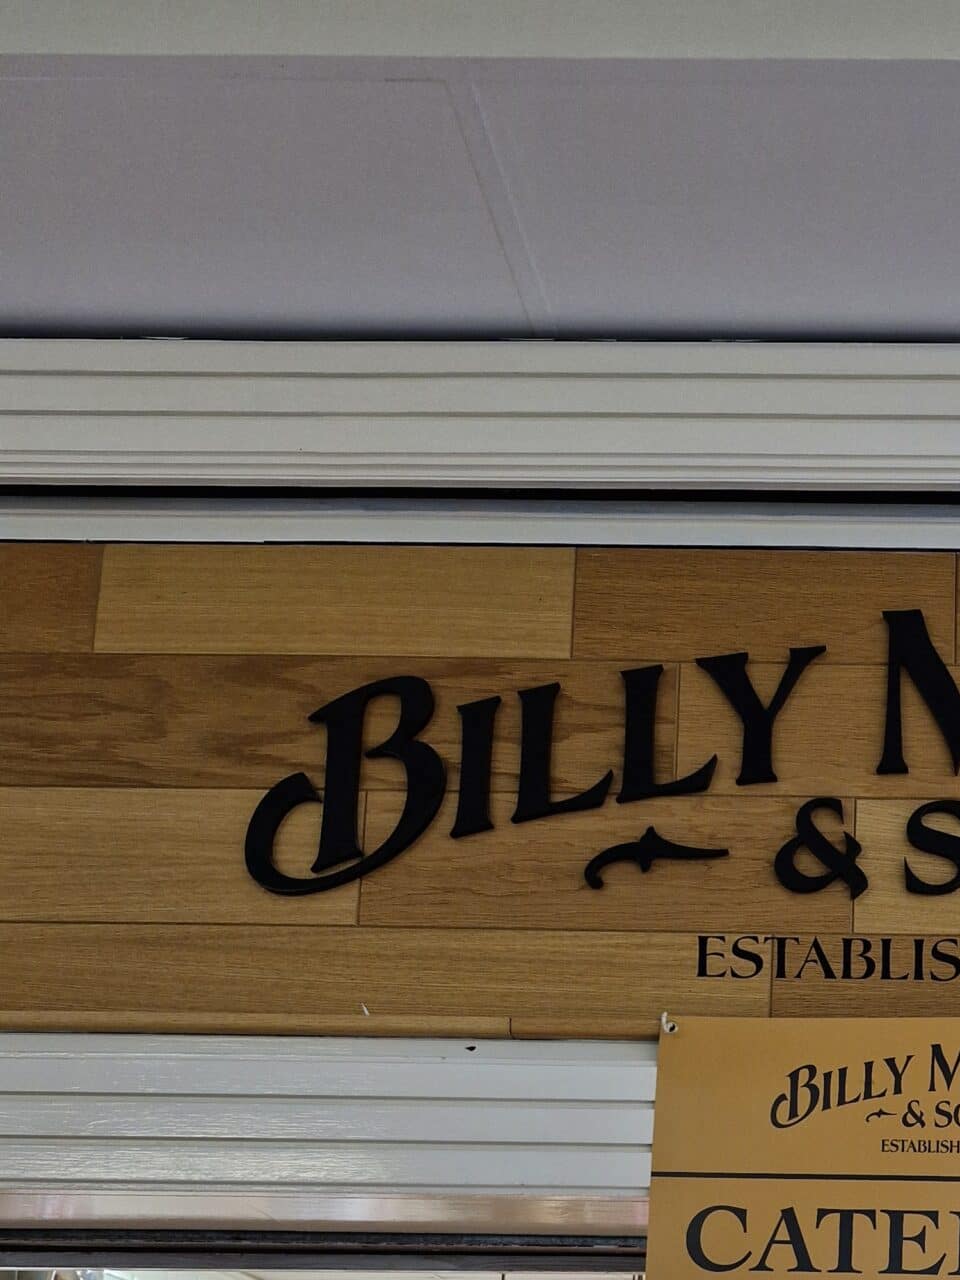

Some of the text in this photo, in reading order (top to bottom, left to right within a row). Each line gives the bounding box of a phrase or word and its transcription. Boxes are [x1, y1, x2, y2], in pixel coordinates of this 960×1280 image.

[245, 646, 826, 897] BILLY
[774, 797, 868, 899] &
[770, 1054, 914, 1129] BILLY
[901, 1100, 926, 1129] &
